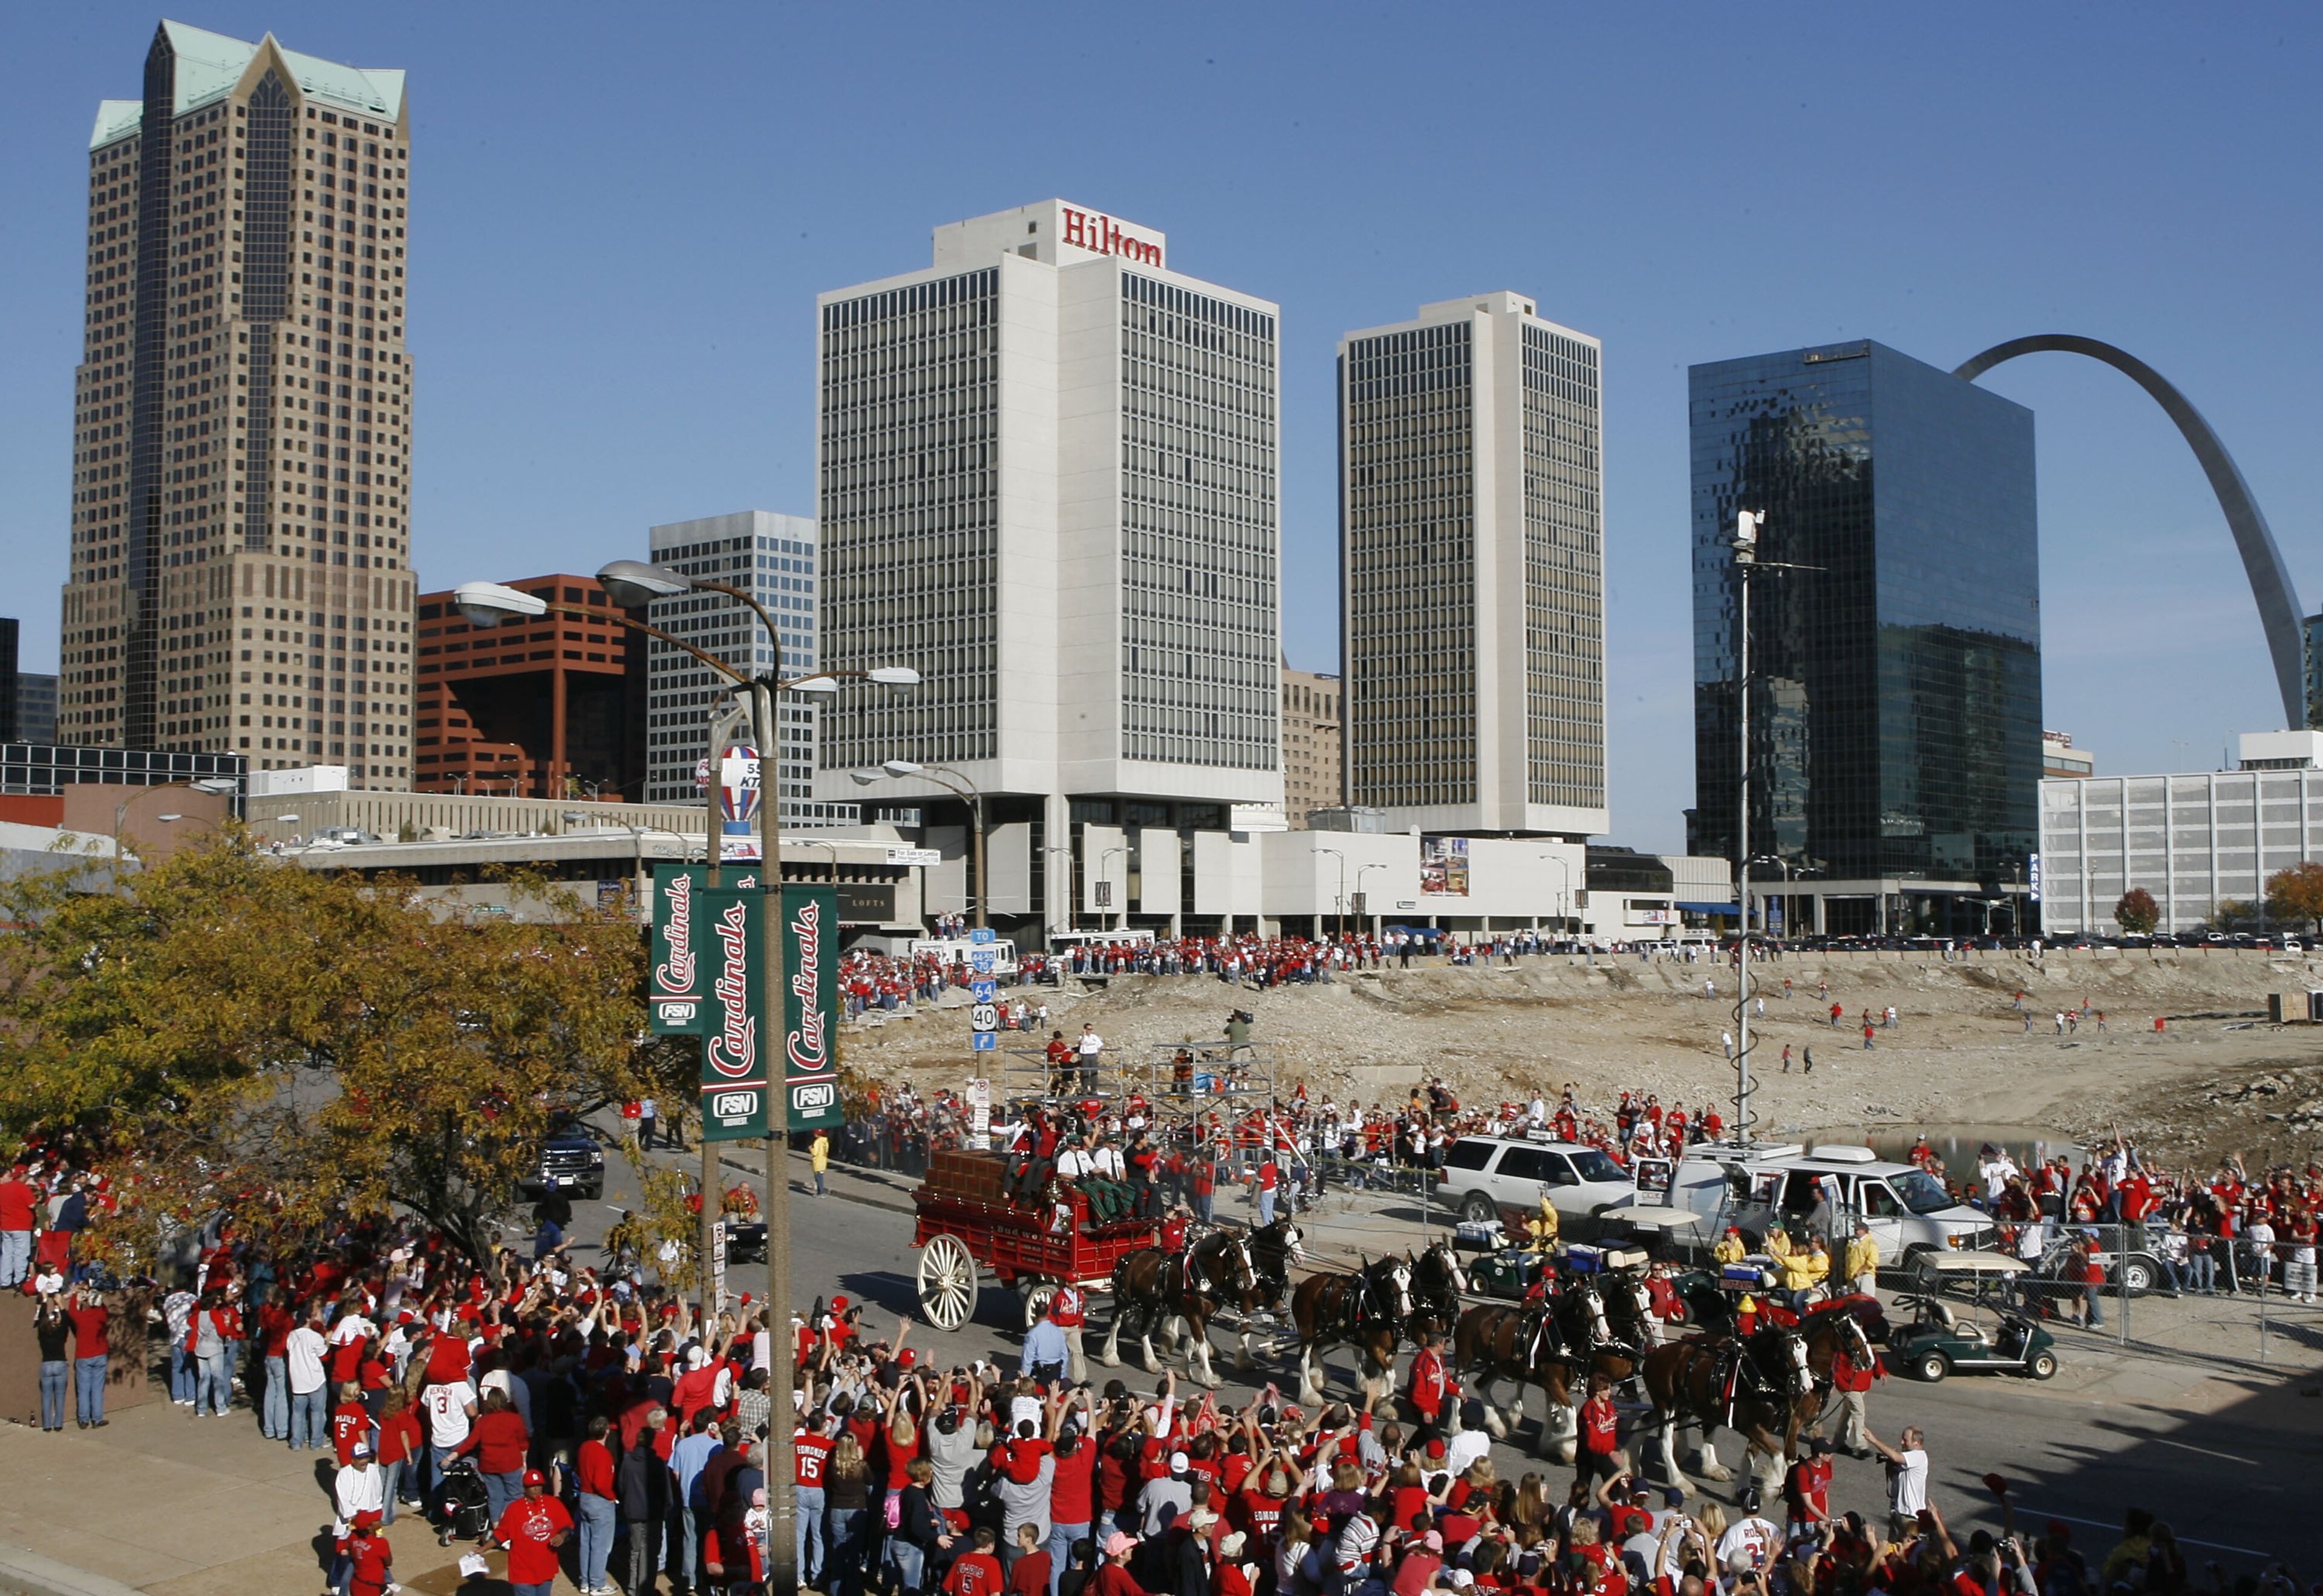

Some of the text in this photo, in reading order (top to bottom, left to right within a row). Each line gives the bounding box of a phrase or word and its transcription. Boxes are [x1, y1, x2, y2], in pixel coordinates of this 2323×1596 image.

[1062, 208, 1162, 268] Hilton
[2030, 854, 2039, 891] PARK
[656, 872, 696, 993] Cardinals
[708, 900, 755, 1078] Cardinals
[788, 899, 827, 1071] Cardinals
[975, 984, 992, 998] 64
[665, 1005, 690, 1018] FSN
[975, 1010, 993, 1024] 40
[720, 1094, 751, 1114] FSN
[800, 1087, 828, 1106] FSN
[437, 1396, 447, 1414] 3
[340, 1423, 348, 1438] 5
[797, 1445, 828, 1459] EDMONDS
[801, 1457, 819, 1478] 15
[962, 1574, 973, 1594] 5
